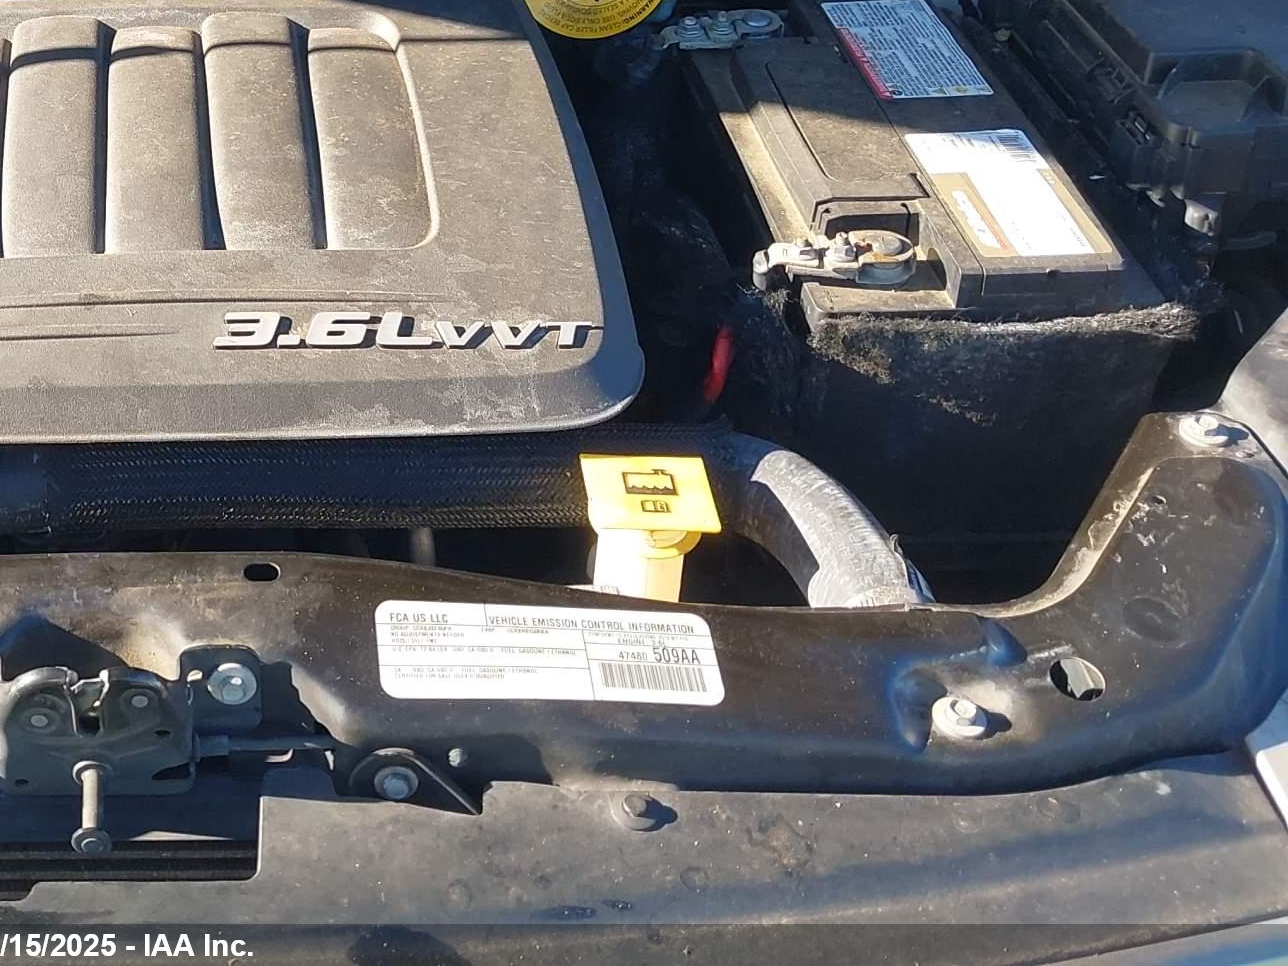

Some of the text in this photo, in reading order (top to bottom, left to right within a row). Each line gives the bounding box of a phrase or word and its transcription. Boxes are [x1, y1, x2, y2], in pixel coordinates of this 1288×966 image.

[389, 612, 449, 624] FCA US LLC
[489, 616, 694, 634] VEHICLE EMISSION CONTROL INFORMATION
[653, 647, 701, 664] 509AA
